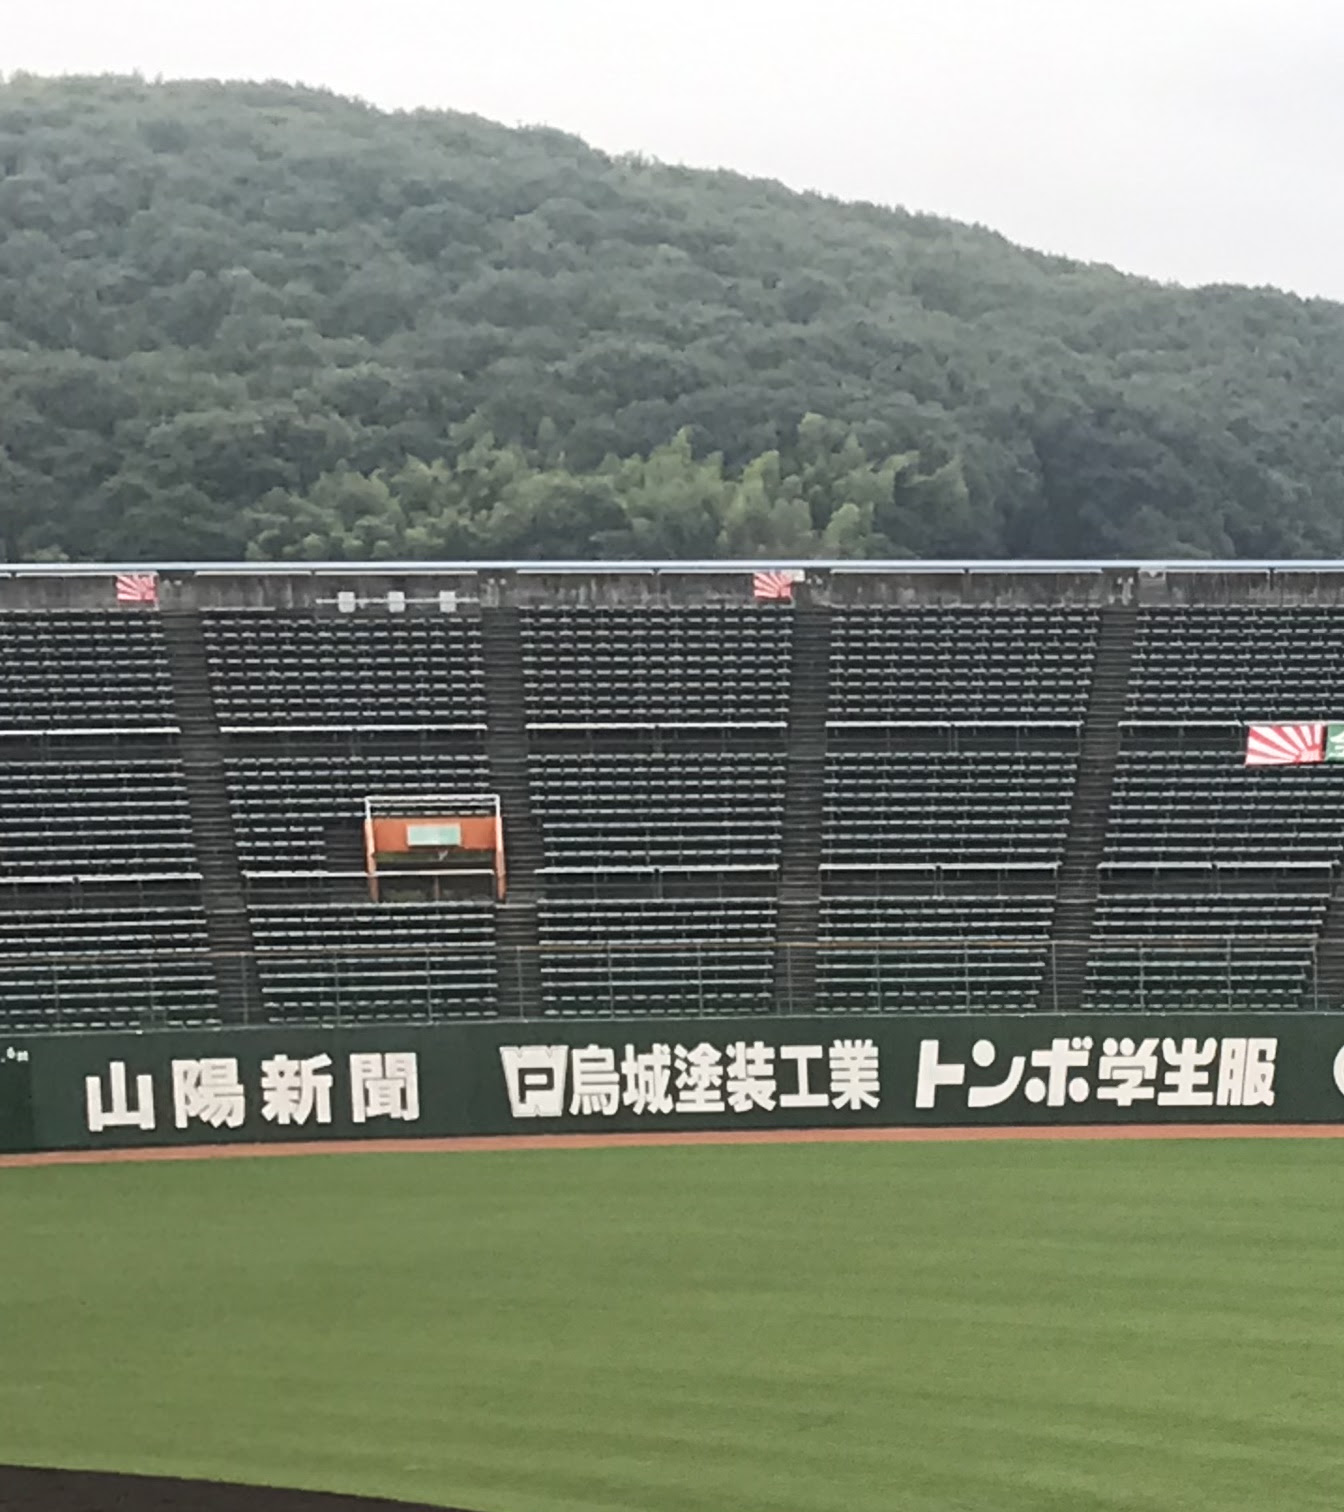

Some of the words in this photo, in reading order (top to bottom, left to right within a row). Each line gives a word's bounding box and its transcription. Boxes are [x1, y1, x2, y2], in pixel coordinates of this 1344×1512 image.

[85, 1051, 421, 1132] 山陽新聞
[914, 1035, 1278, 1109] トンボ学生服
